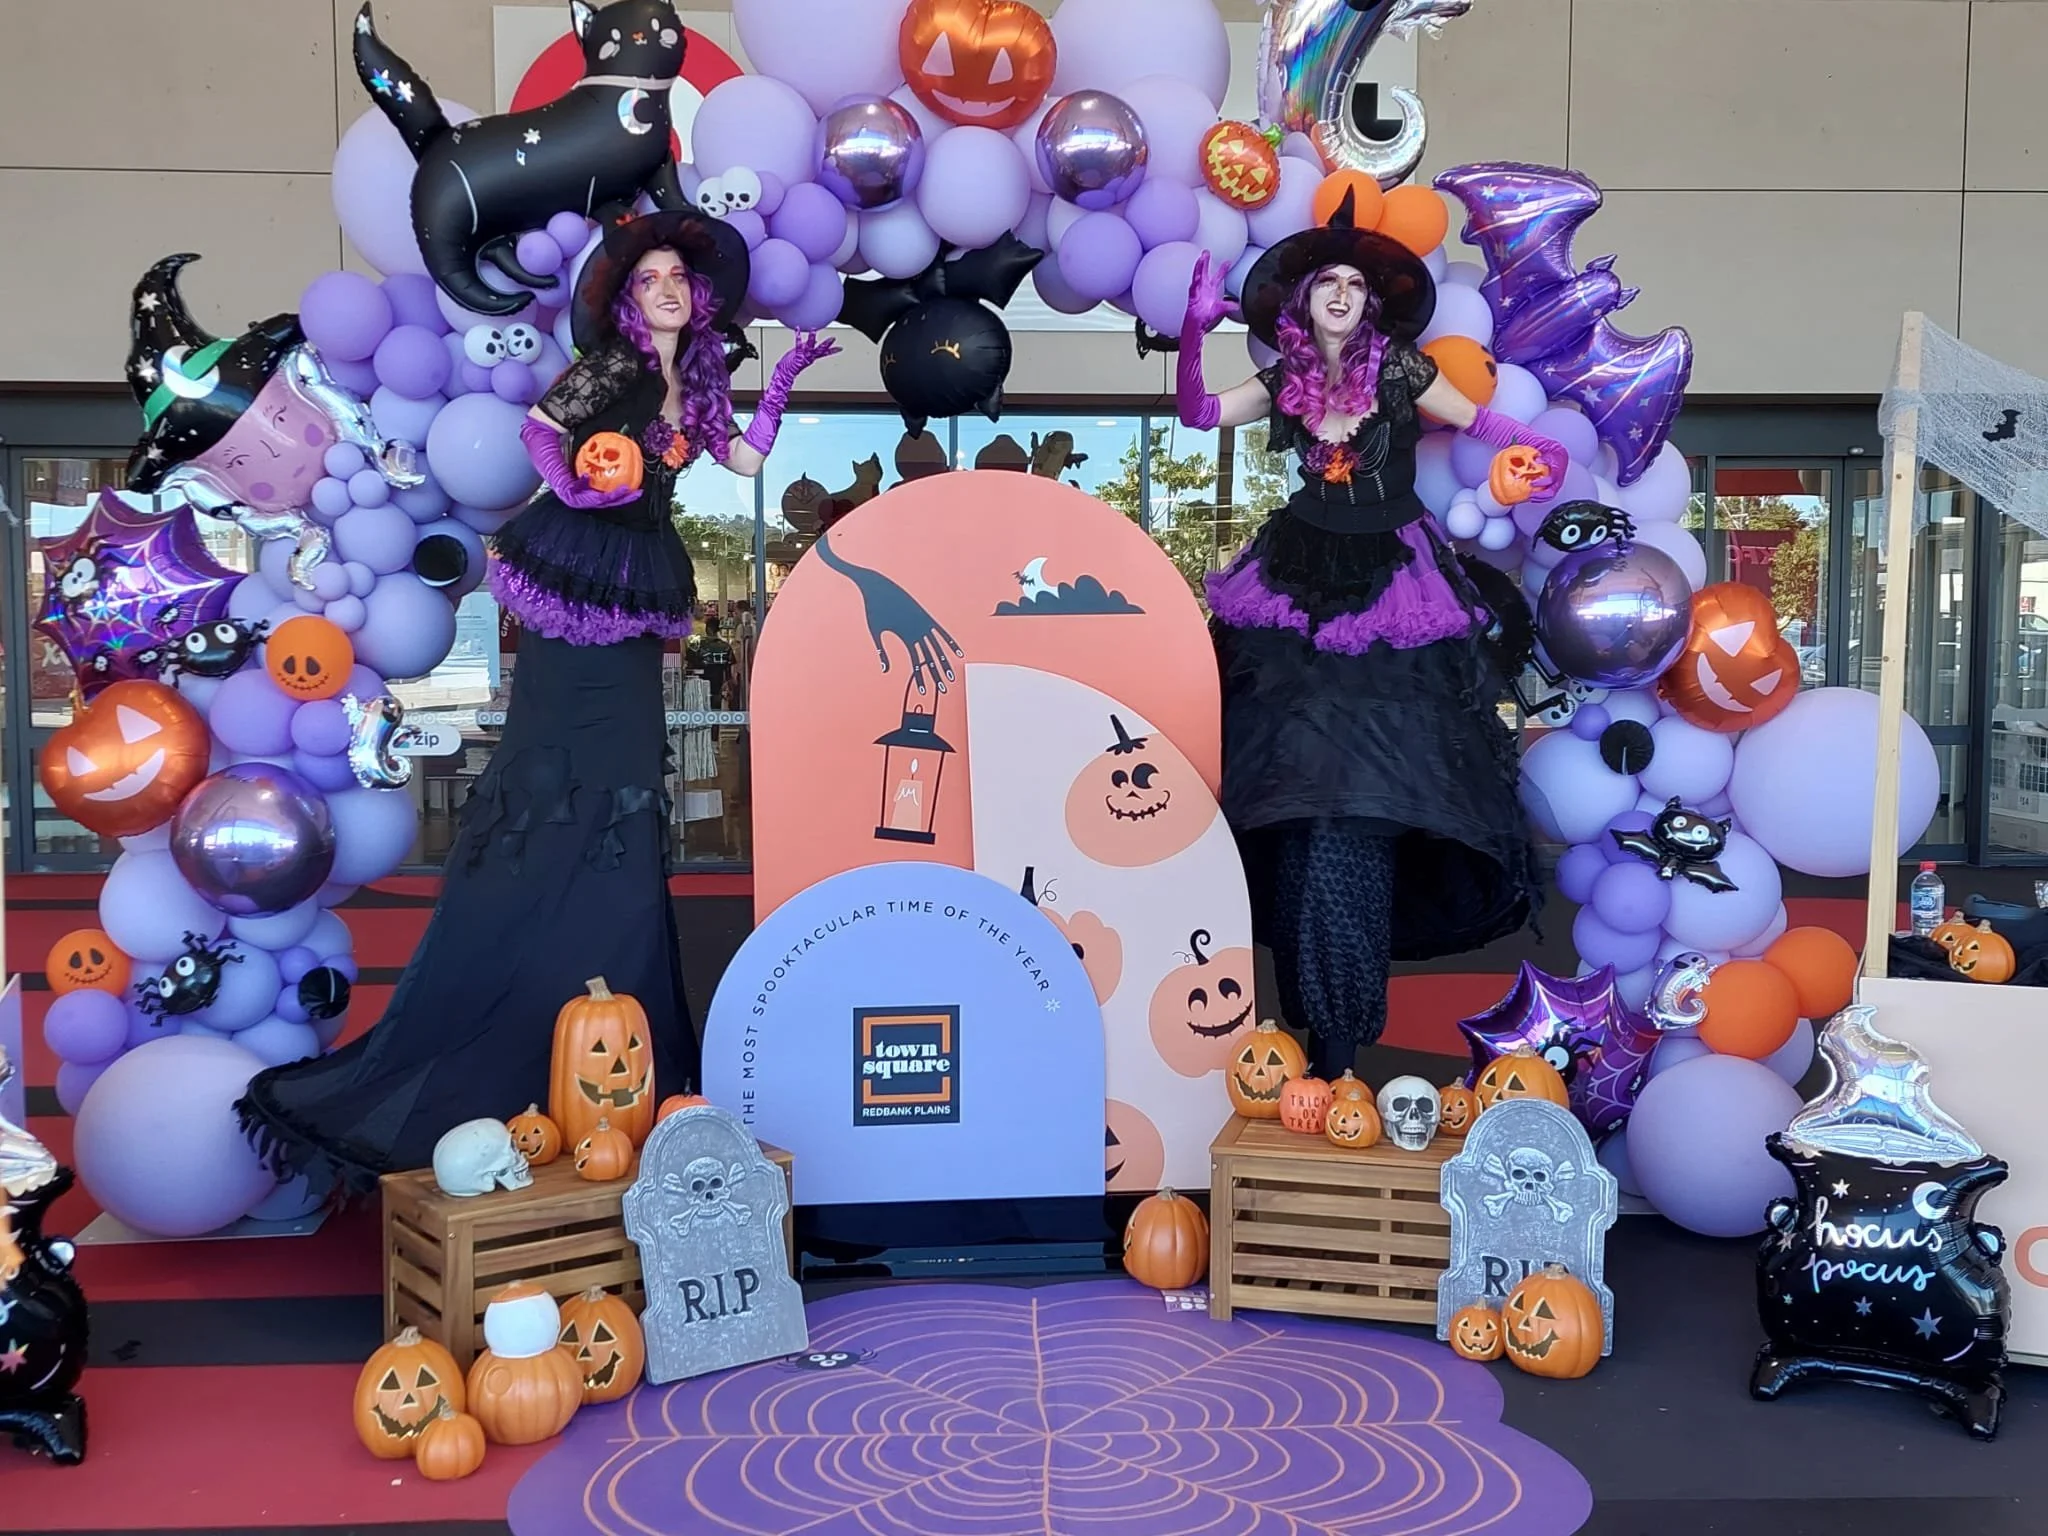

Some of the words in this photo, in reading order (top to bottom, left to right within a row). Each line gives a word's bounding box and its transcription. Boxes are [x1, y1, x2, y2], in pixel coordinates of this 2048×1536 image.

[414, 731, 440, 748] zip
[887, 900, 934, 913] TIME
[944, 905, 970, 920] OF
[978, 917, 1011, 945] THE
[752, 905, 877, 1016] SPOOKTACULAR
[1015, 945, 1050, 992] YEAR
[742, 1025, 759, 1079] MOST
[875, 1040, 938, 1058] town
[862, 1059, 951, 1079] square
[742, 1089, 755, 1125] THE
[1290, 1094, 1328, 1108] TRICK
[862, 1106, 912, 1118] REDBANK
[914, 1104, 951, 1116] PLAINS
[1302, 1108, 1317, 1119] OR
[1289, 1116, 1321, 1129] TREA
[1807, 1196, 1944, 1252] hocus
[1800, 1252, 1936, 1293] pocus
